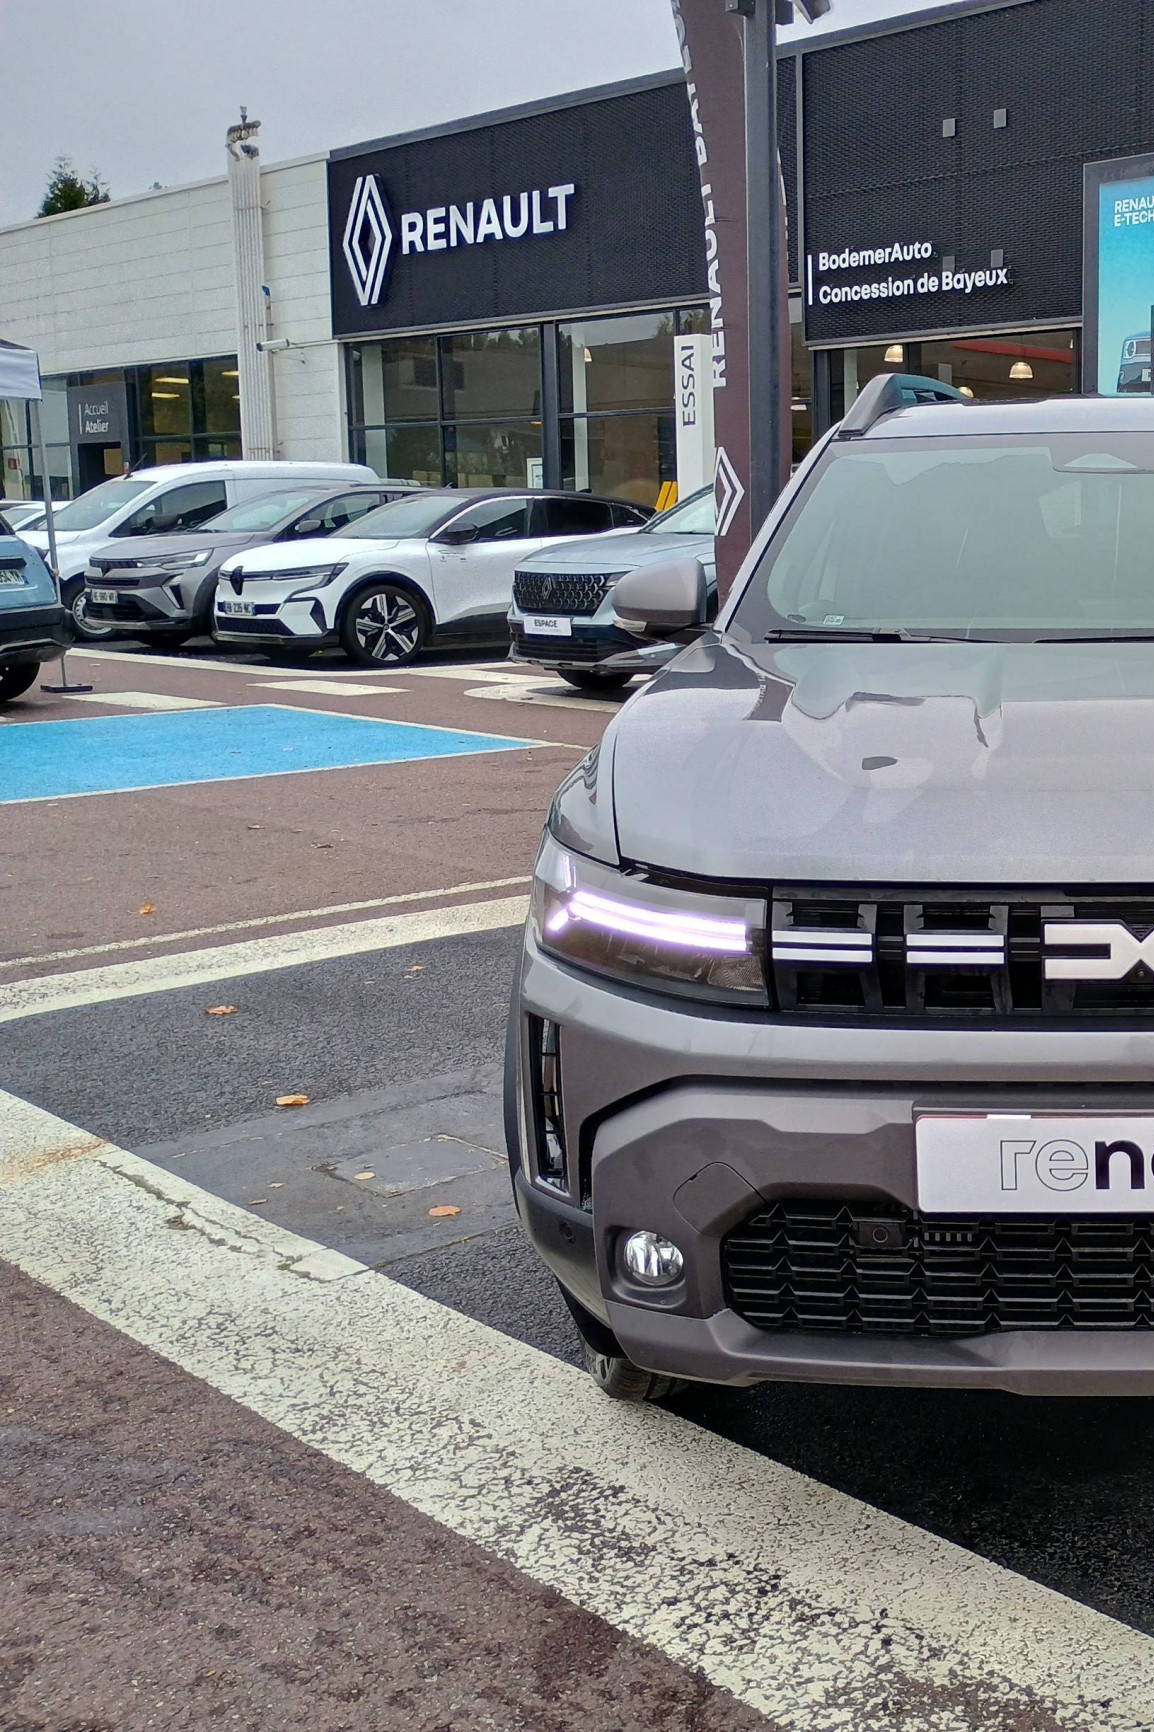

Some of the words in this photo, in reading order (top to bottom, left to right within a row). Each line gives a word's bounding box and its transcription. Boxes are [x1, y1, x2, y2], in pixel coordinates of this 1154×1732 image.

[401, 183, 575, 255] RENAULT
[818, 242, 933, 271] BodemerAuto
[818, 276, 914, 304] Concession
[916, 273, 939, 294] de
[941, 268, 1009, 293] Bayeux
[681, 345, 696, 427] ESSAI
[84, 401, 109, 415] Accueil
[85, 418, 109, 433] Atelier
[533, 618, 559, 628] ESPACE
